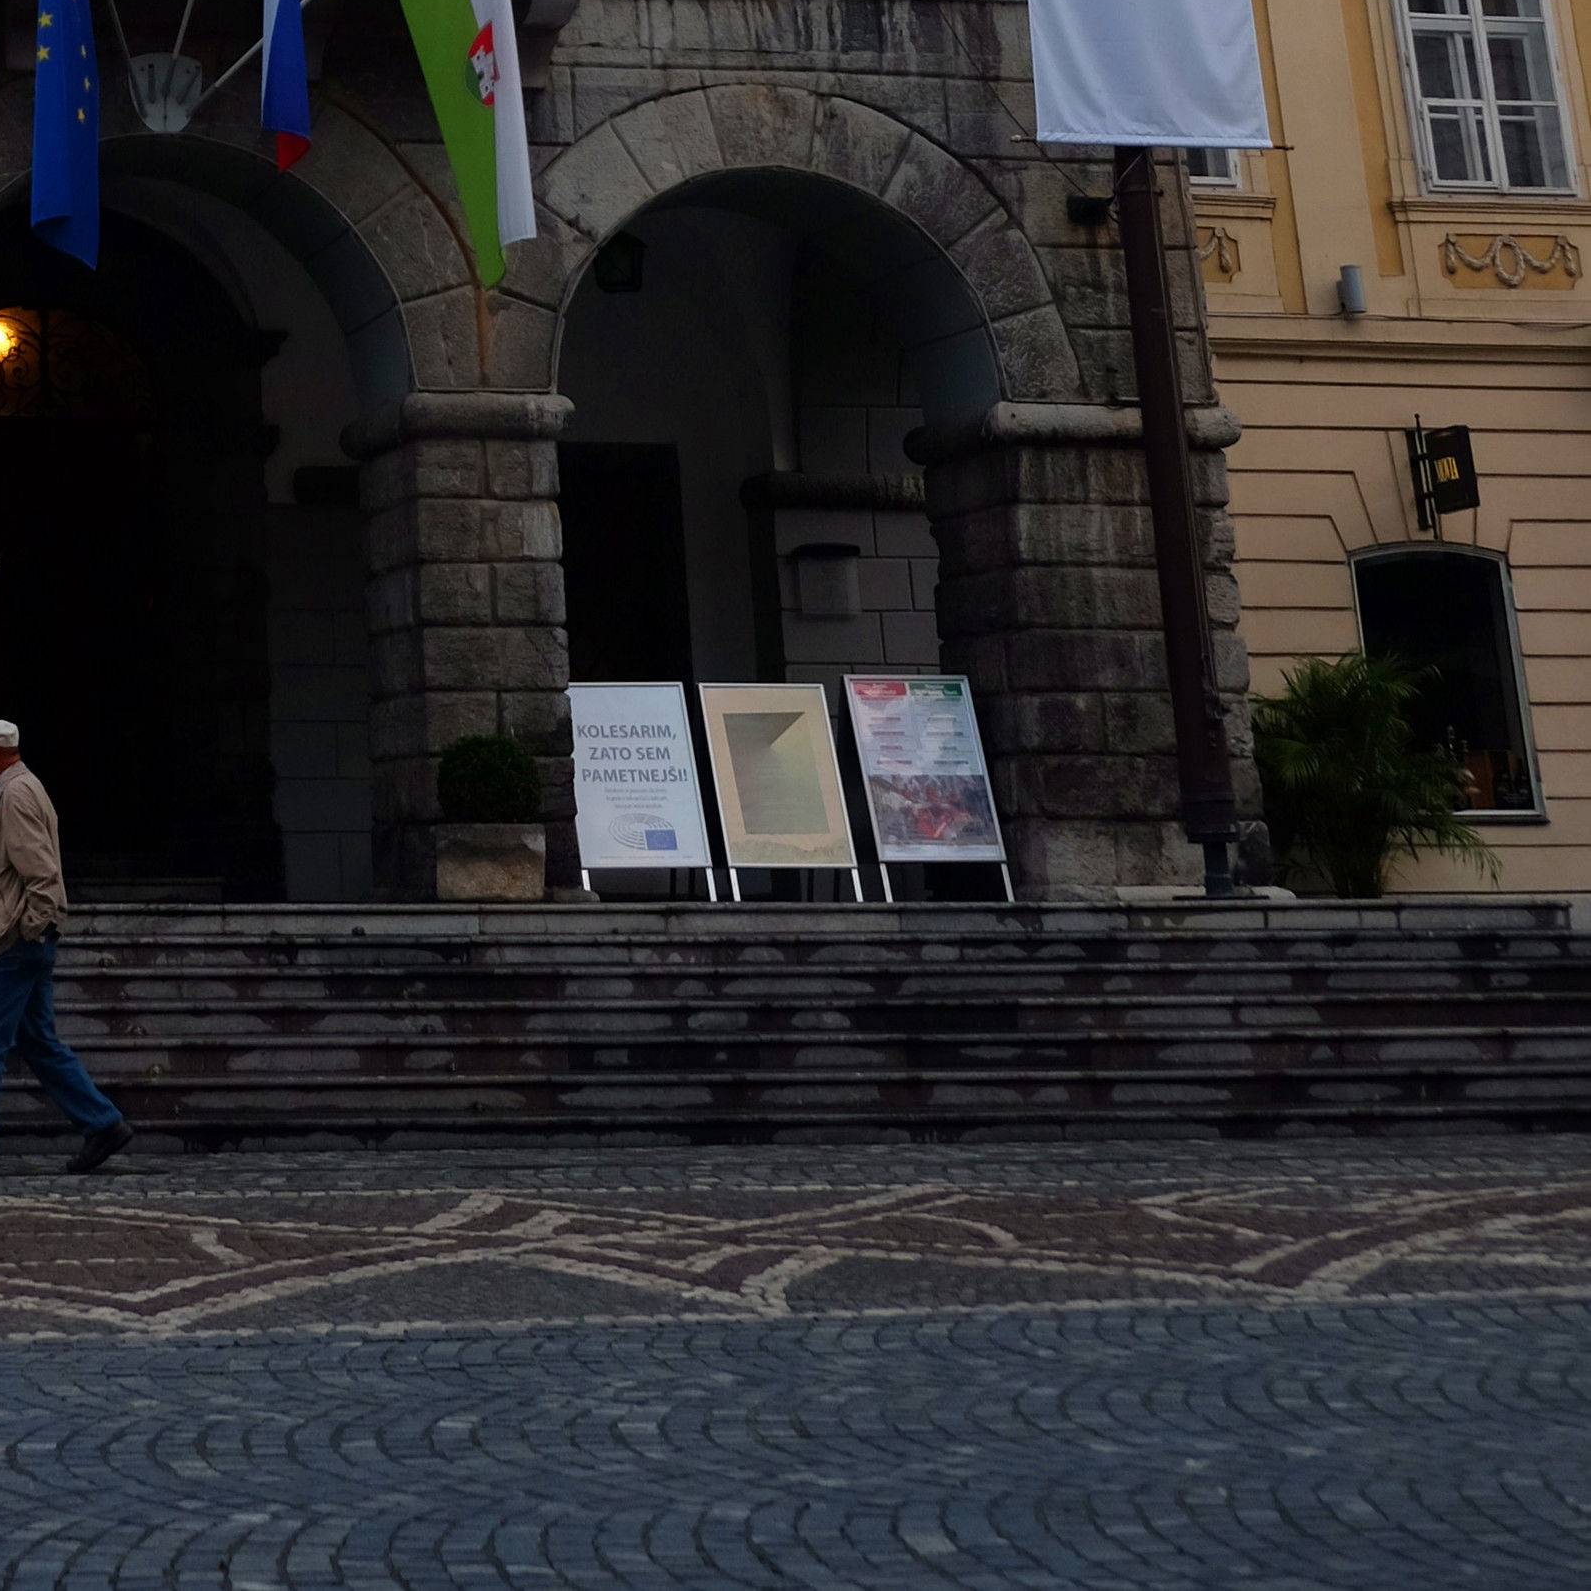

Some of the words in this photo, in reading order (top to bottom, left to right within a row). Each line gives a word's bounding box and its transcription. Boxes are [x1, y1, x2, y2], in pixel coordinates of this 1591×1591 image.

[577, 724, 677, 740] KOLESARIM,
[589, 747, 632, 760] ZATO
[637, 747, 671, 761] SEM
[582, 766, 688, 783] PAMETNEJŠI!
